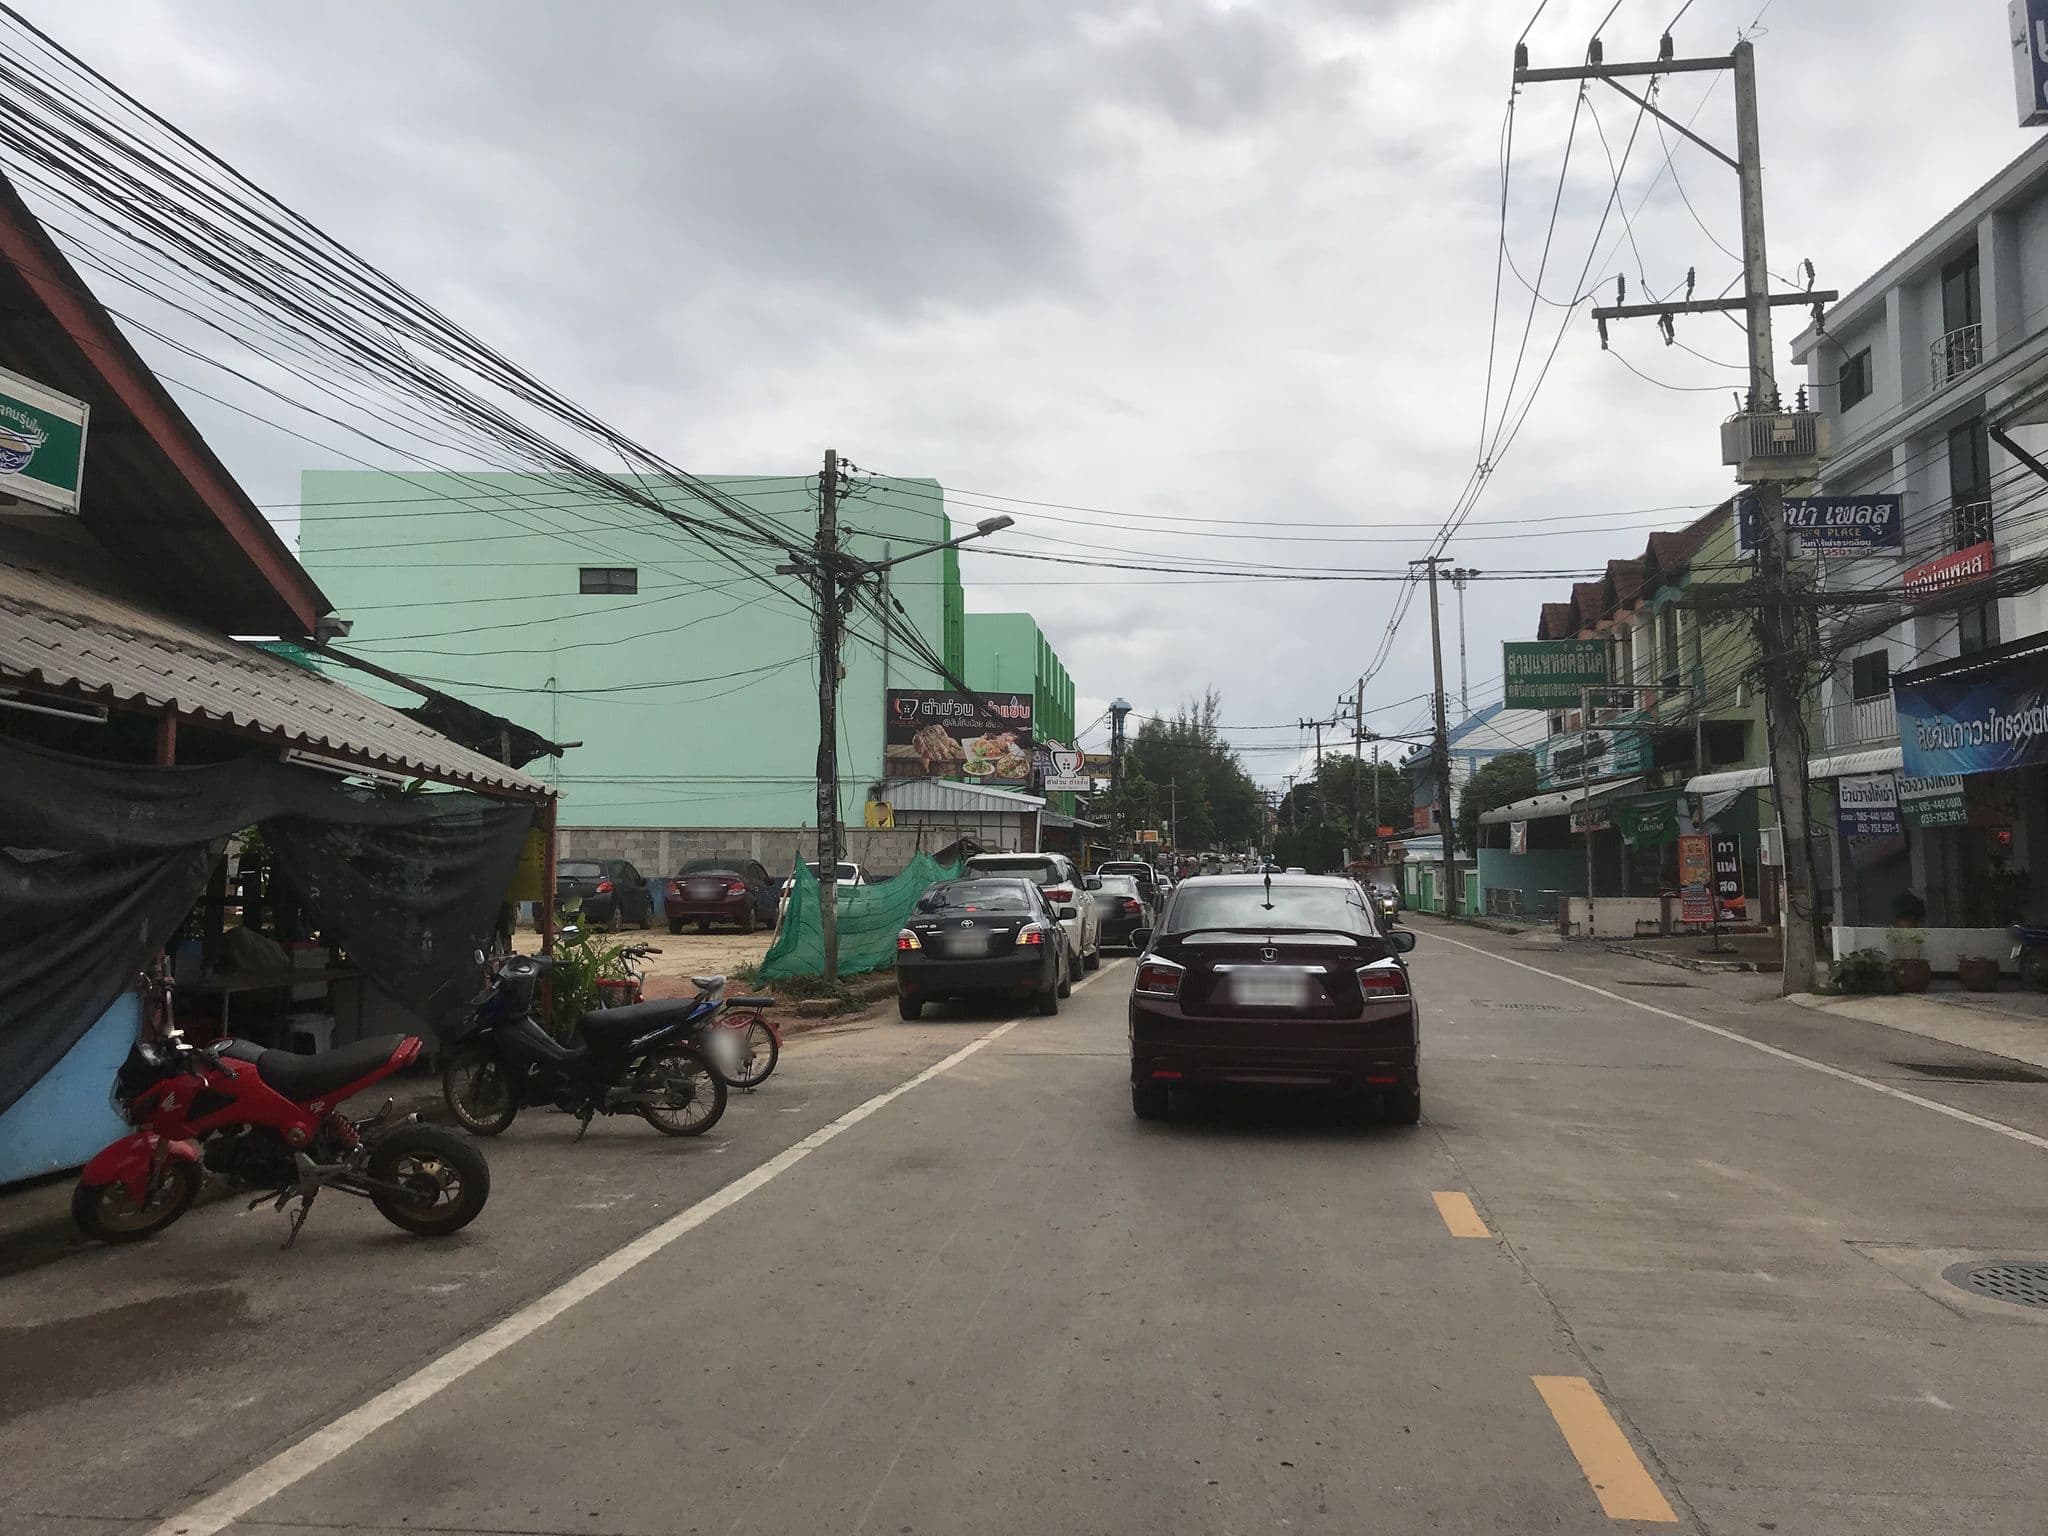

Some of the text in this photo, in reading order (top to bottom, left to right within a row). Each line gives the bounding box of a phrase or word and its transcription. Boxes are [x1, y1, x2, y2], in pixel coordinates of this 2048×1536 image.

[1827, 529, 1862, 537] PLACE
[1718, 841, 1734, 853] กา
[1717, 857, 1737, 873] แฟ
[1719, 880, 1738, 893] สด
